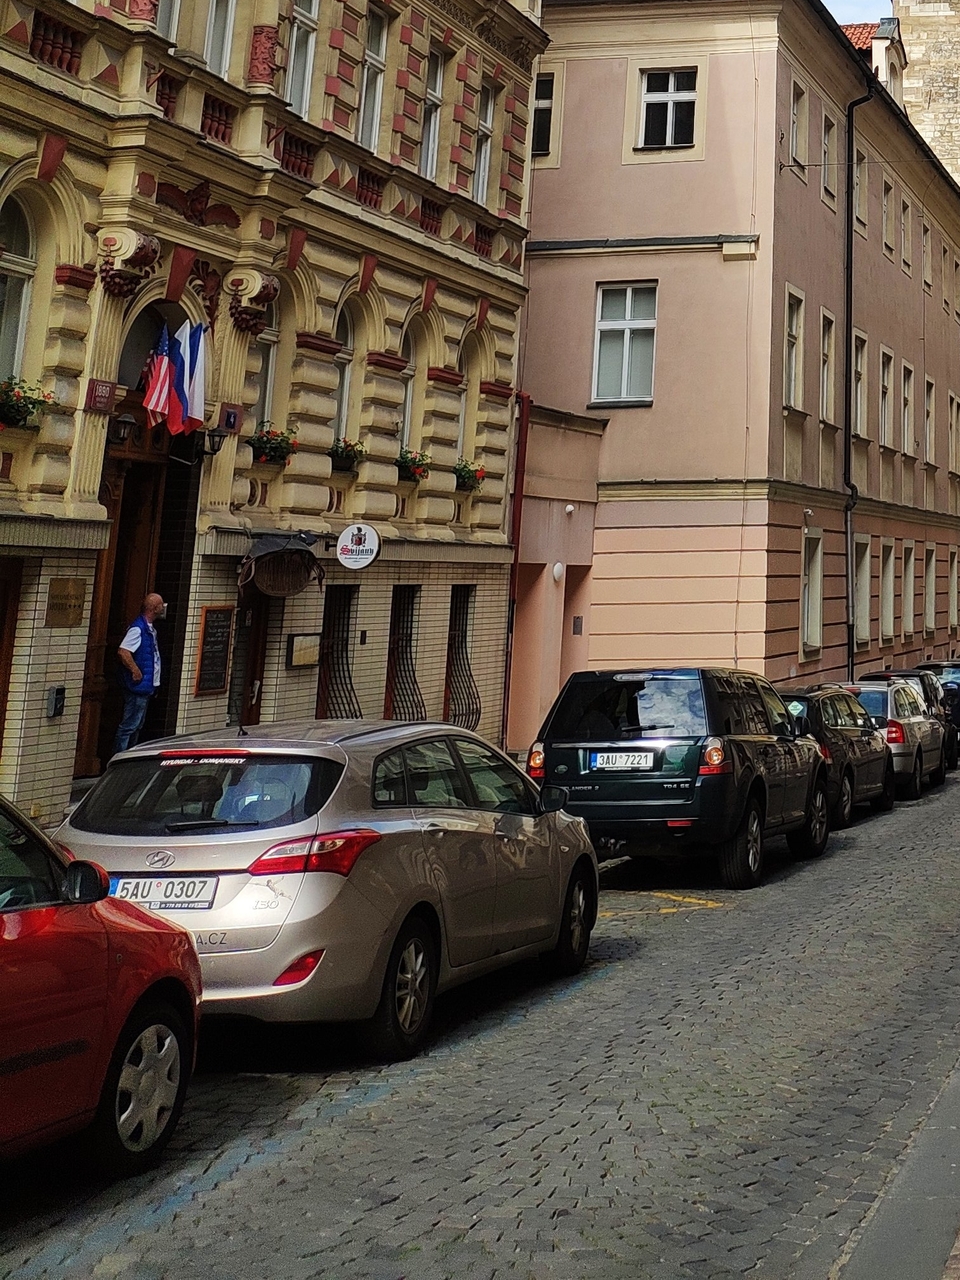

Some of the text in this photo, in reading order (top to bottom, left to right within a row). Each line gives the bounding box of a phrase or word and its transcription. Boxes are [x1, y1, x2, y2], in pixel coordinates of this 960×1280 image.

[599, 753, 649, 766] 3AU 7221
[120, 880, 208, 900] 5AU 0307
